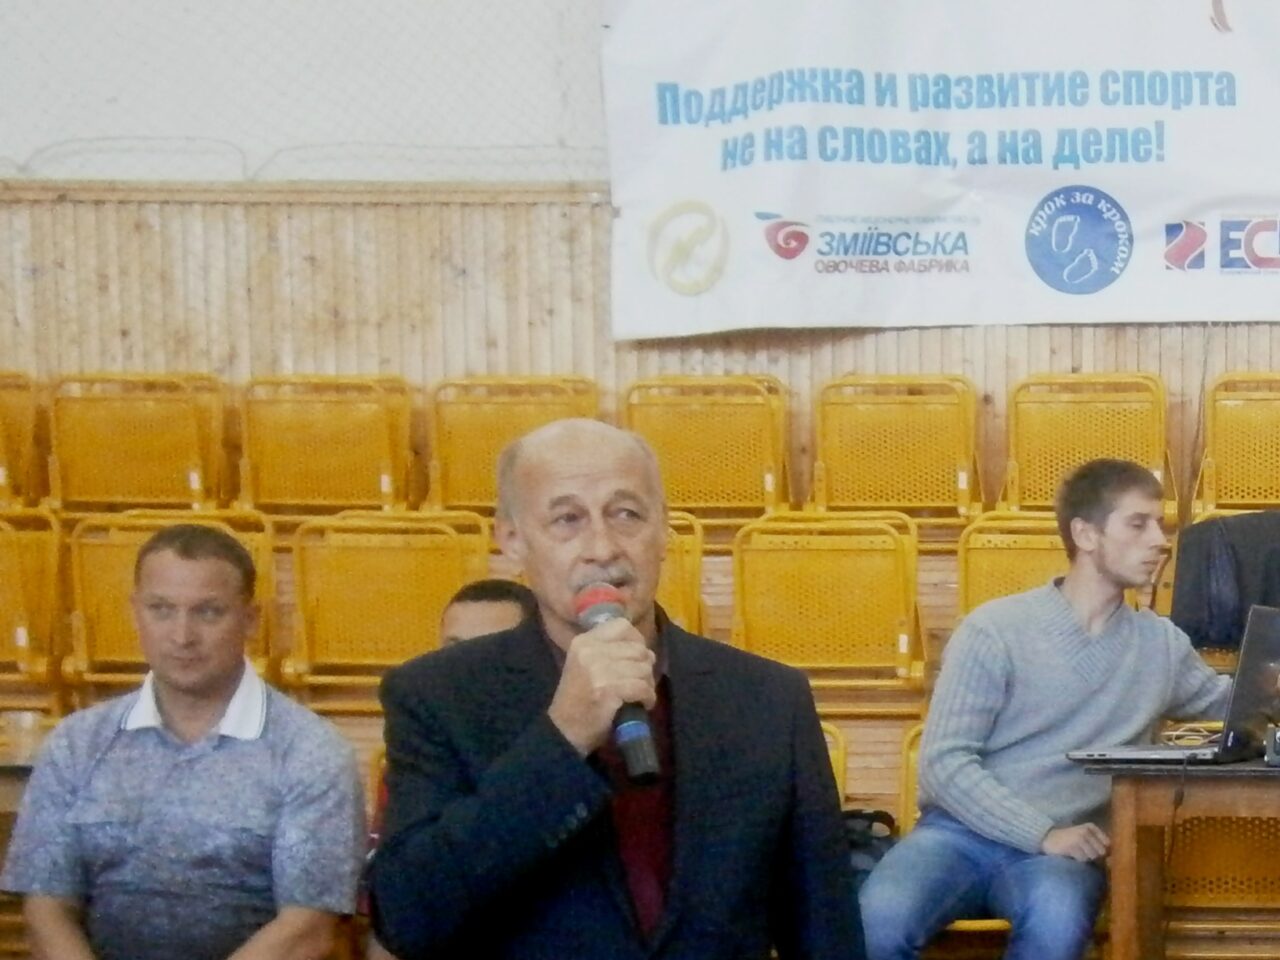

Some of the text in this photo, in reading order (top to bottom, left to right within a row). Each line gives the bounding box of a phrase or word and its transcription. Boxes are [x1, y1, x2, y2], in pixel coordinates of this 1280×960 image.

[655, 66, 1237, 128] Поддержка и развитие спорта
[720, 119, 1166, 172] не на словах, а на деле!
[815, 227, 970, 257] ЗМІЇВСЬКА
[814, 258, 970, 274] ОВОЧЕВА ФАБРИКА
